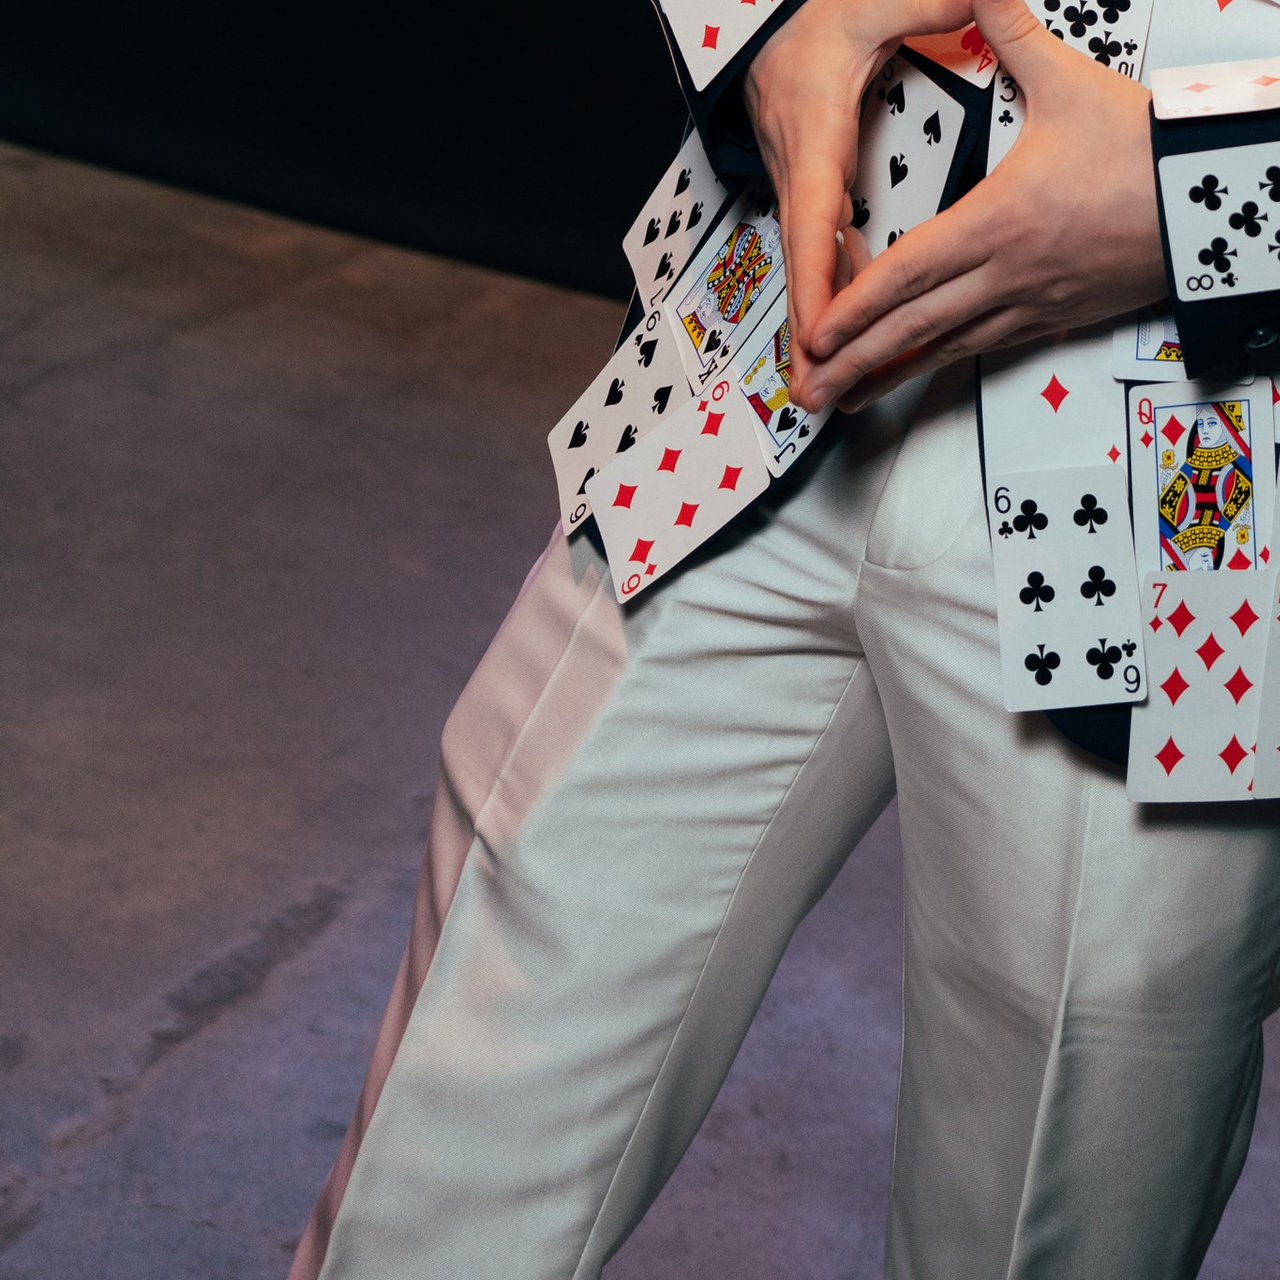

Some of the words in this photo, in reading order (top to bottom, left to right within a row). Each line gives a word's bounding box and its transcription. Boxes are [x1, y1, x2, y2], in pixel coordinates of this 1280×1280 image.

[976, 48, 993, 74] 4
[1000, 76, 1016, 102] 3
[1186, 274, 1214, 291] 8
[698, 359, 718, 384] K
[712, 381, 729, 401] 6
[1136, 398, 1154, 424] Q
[774, 442, 796, 463] J
[995, 487, 1011, 514] 6
[1153, 583, 1167, 608] 7
